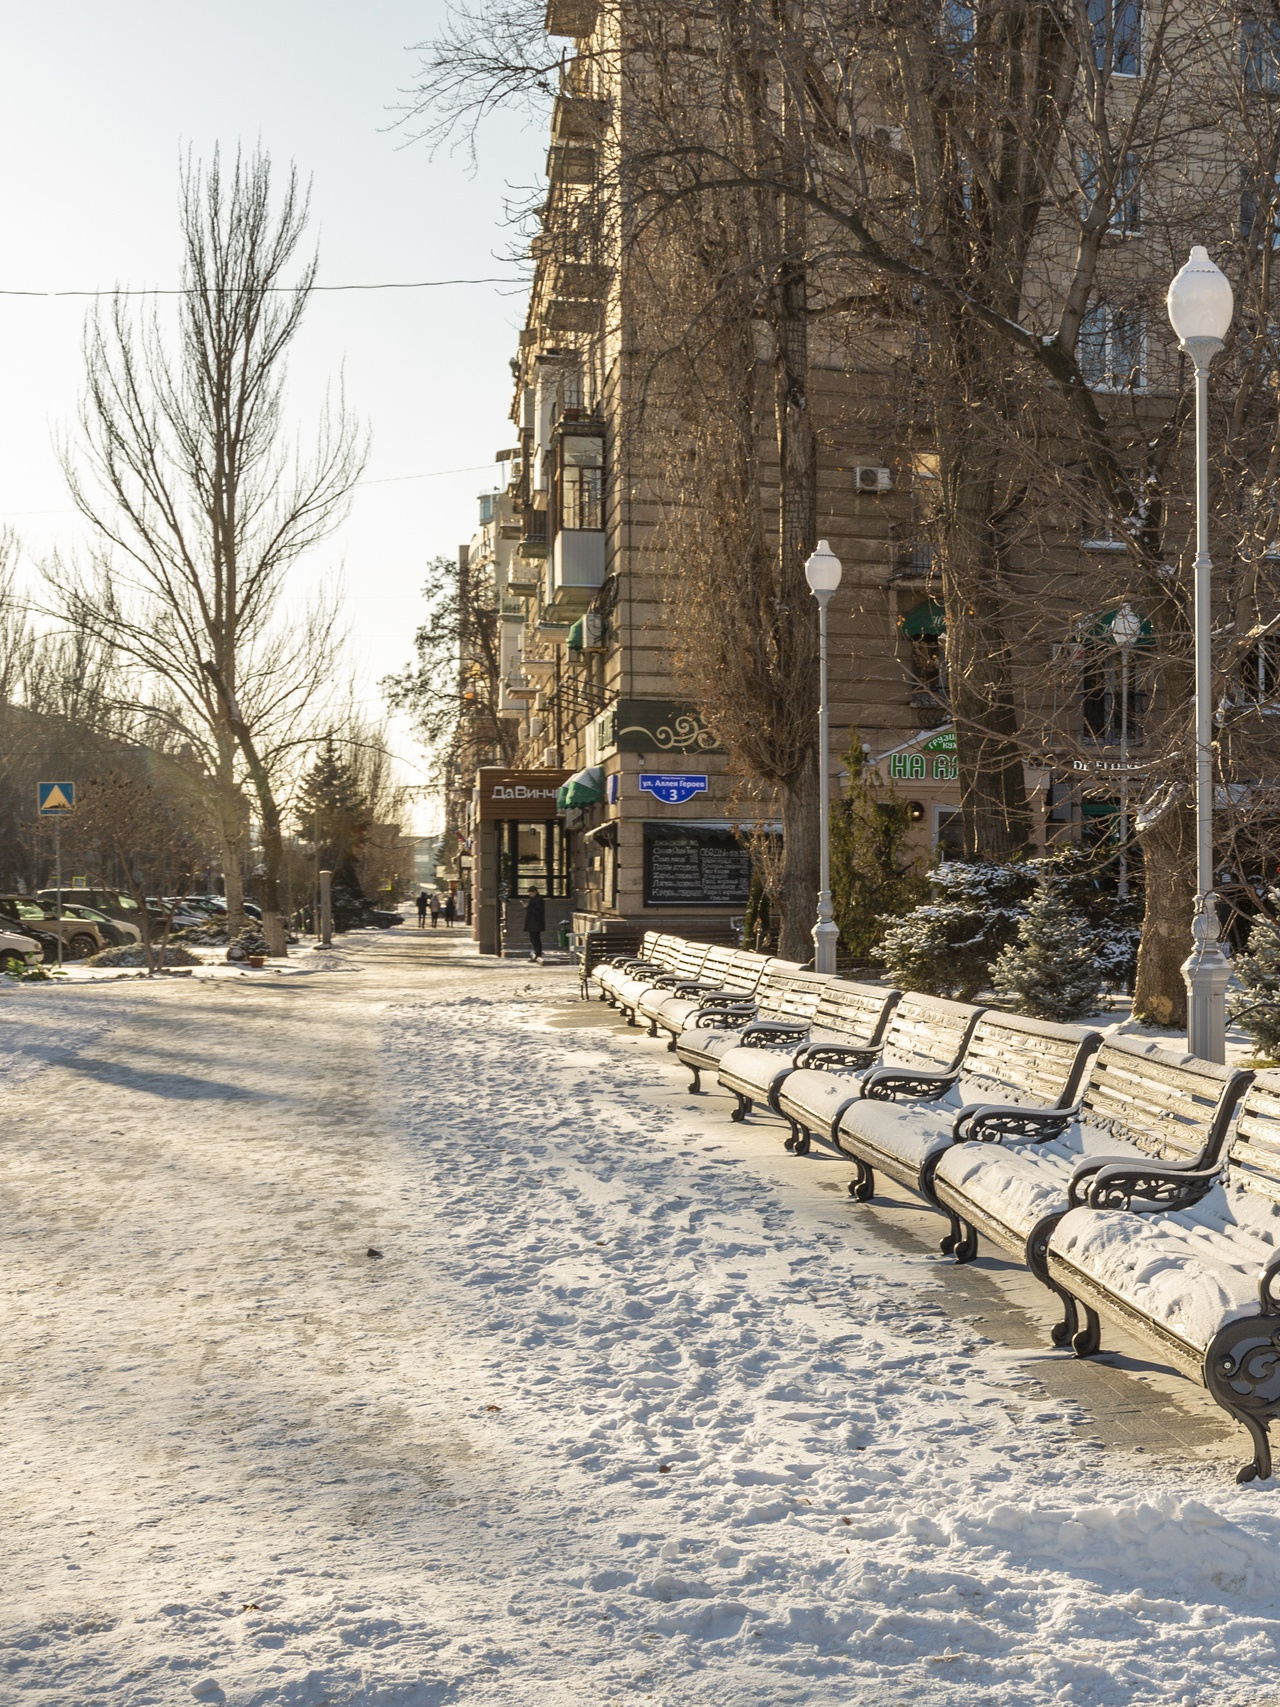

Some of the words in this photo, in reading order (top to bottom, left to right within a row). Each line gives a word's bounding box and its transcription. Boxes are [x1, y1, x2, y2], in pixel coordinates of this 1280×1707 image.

[891, 753, 926, 779] НА
[642, 780, 654, 788] ул.
[679, 780, 705, 788] Героев
[669, 789, 678, 801] 3
